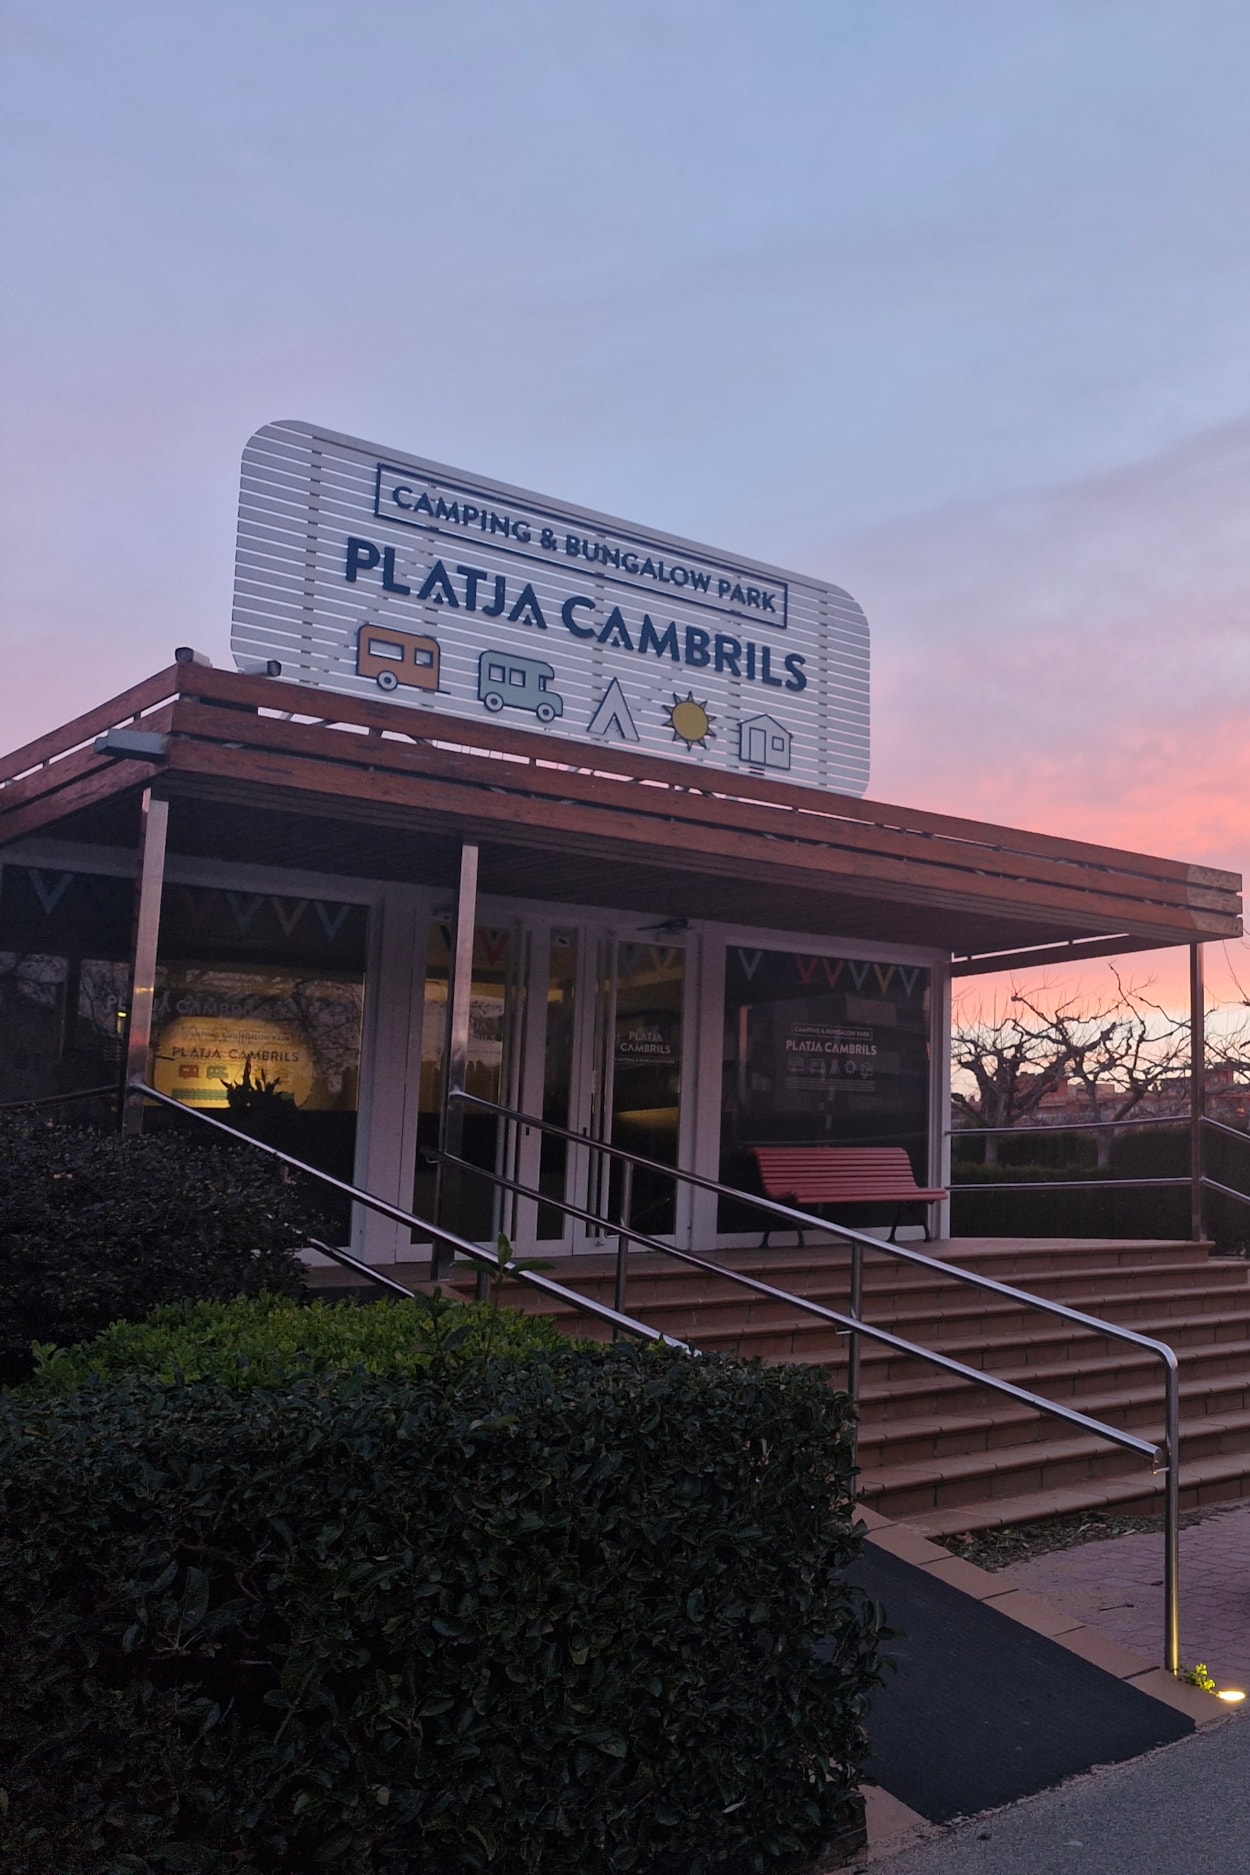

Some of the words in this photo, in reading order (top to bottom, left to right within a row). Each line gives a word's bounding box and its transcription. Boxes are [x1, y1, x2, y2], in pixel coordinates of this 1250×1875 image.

[392, 486, 532, 543] CAMPING
[540, 528, 557, 551] &
[565, 534, 711, 593] BUNGALOW
[718, 578, 776, 613] PARK
[345, 536, 548, 630] PLATJA
[561, 595, 807, 692] CAMBRILS
[629, 1031, 663, 1042] PLATJA
[171, 1046, 222, 1060] PLATJA
[228, 1048, 300, 1063] CAMBRILS
[619, 1042, 672, 1054] CAMBRILS
[786, 1039, 823, 1052] PLATJA
[824, 1041, 878, 1056] CAMBRILS
